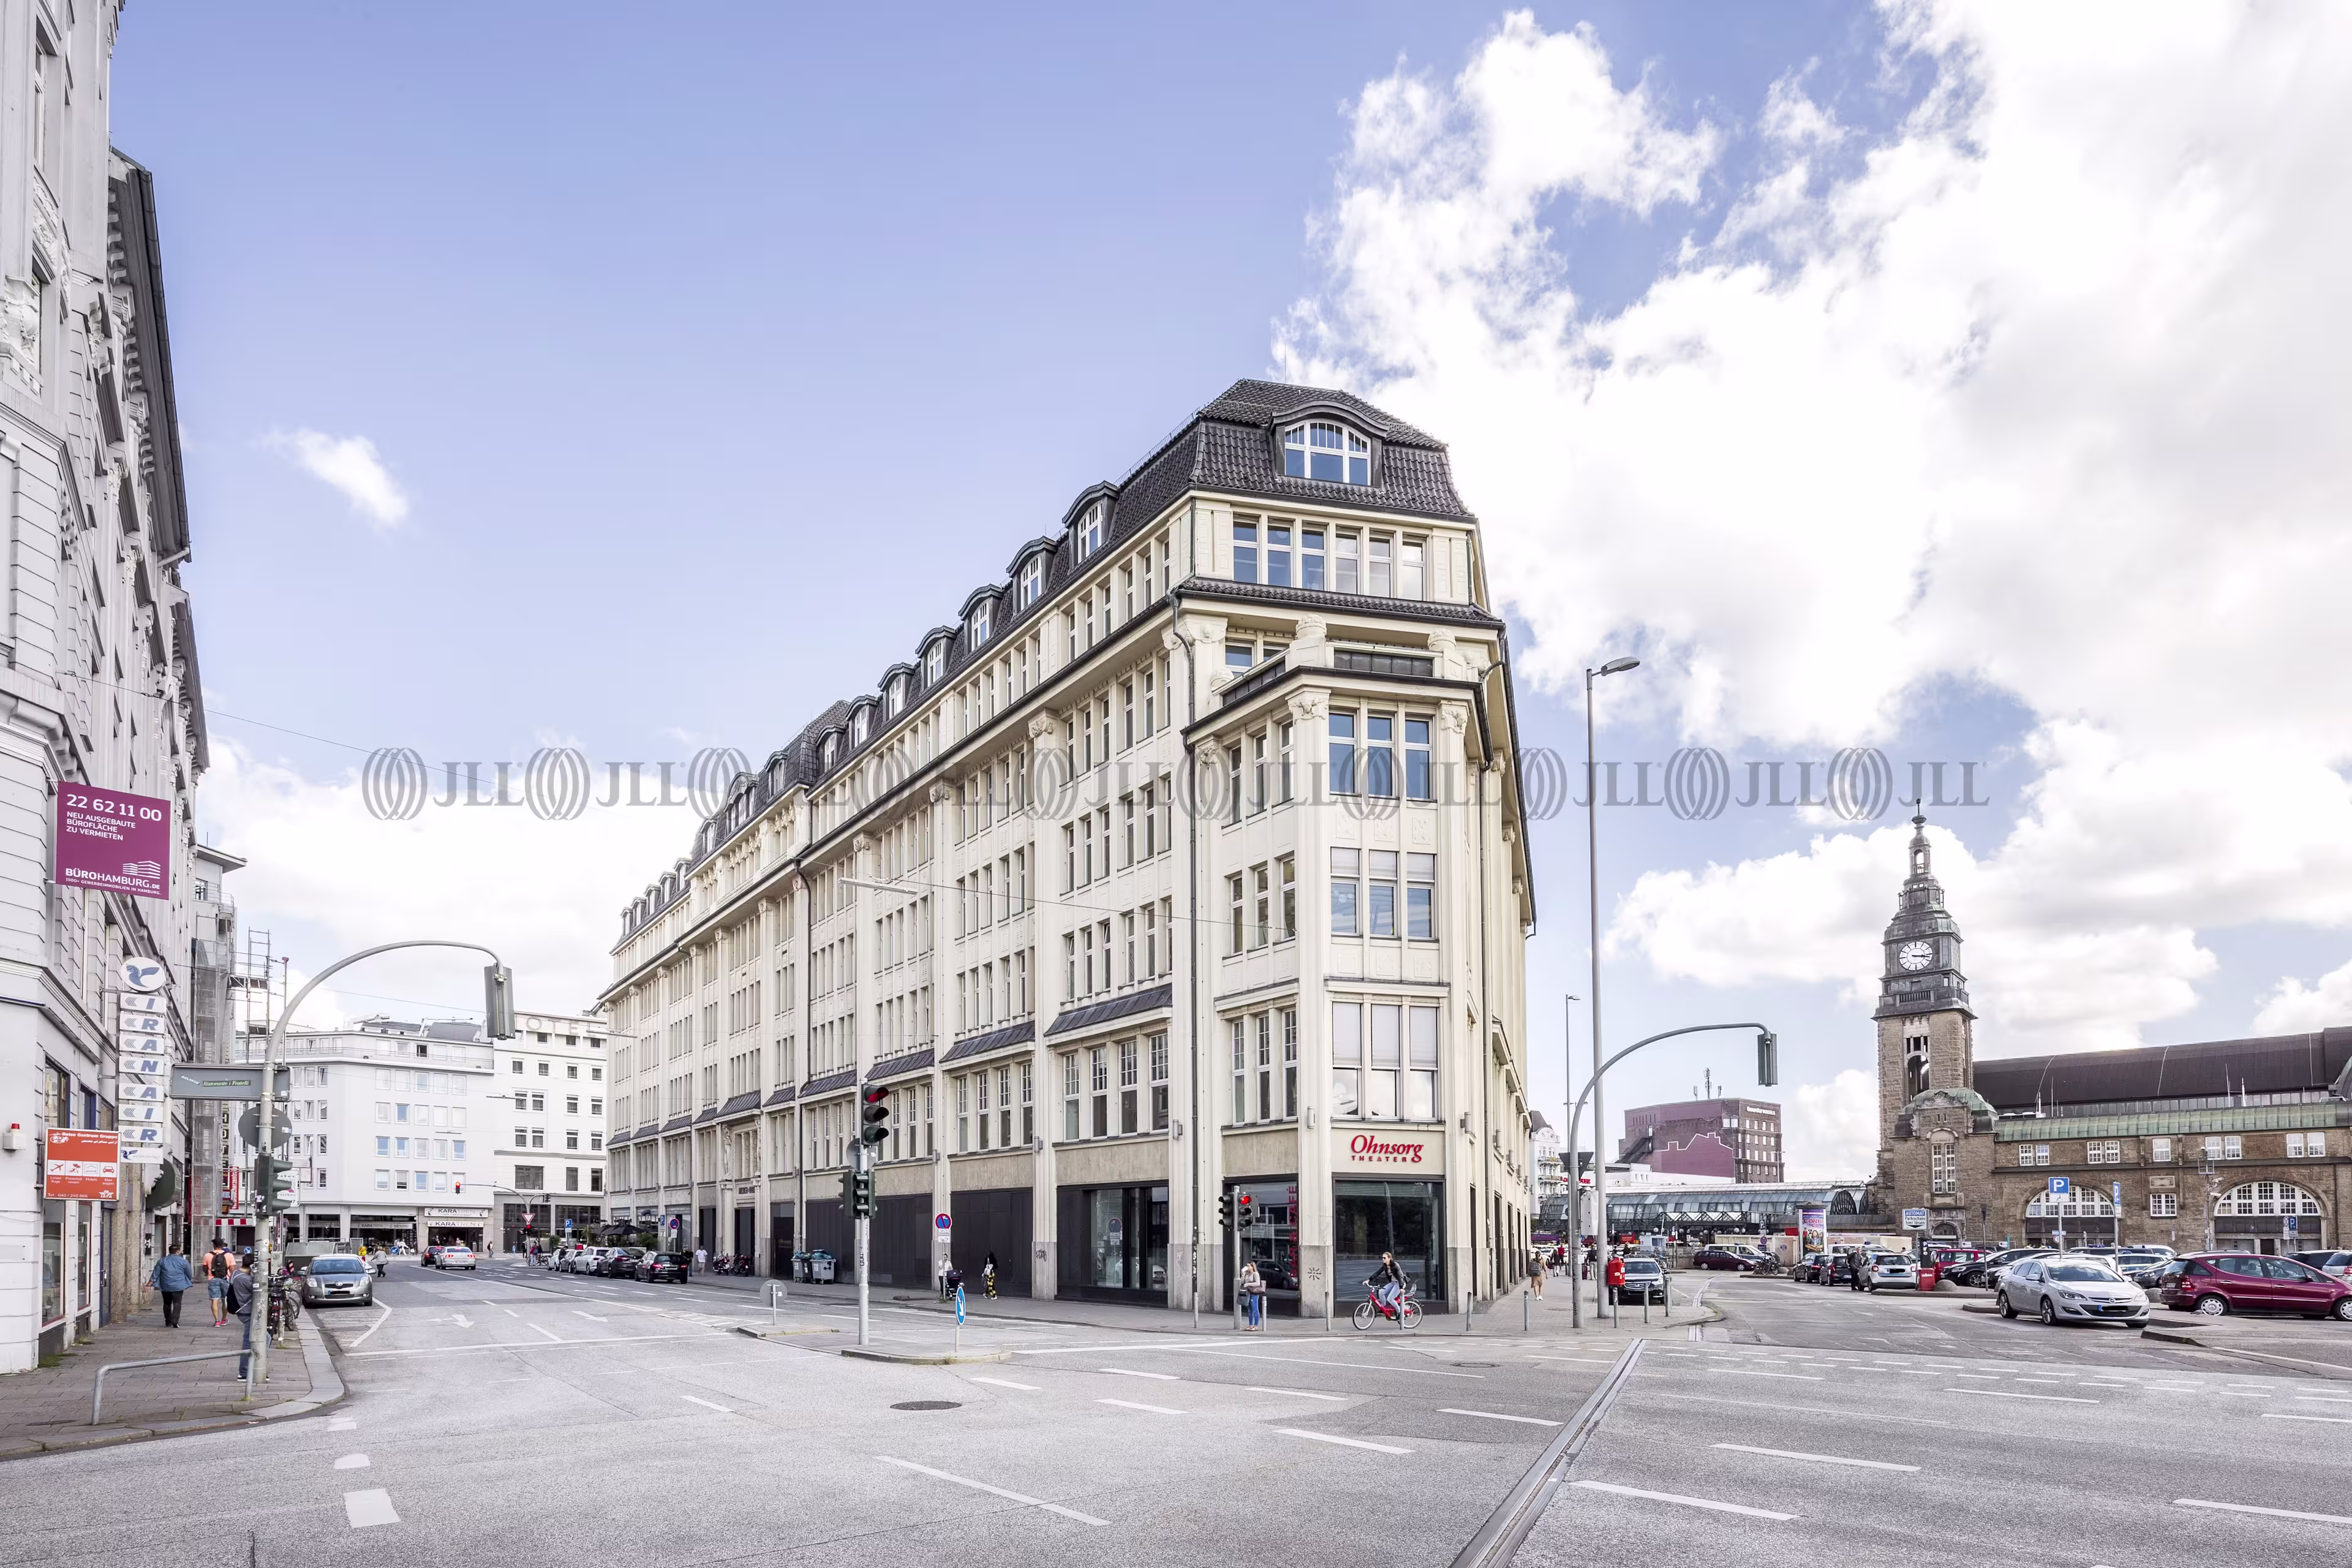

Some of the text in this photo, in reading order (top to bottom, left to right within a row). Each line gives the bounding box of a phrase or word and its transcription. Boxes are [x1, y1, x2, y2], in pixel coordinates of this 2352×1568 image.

[67, 794, 162, 821] 22 62 11 00
[67, 819, 118, 832] BÜROFLÄCHE
[86, 815, 136, 828] AUSGEBAUTE
[80, 828, 123, 840] VERMIETEN
[66, 868, 160, 889] BÜROHAMBURG.DE
[81, 880, 130, 890] GEWERBEIMMOBILIEN
[526, 1016, 597, 1037] OTEL
[1351, 1134, 1424, 1163] Ohnsorg
[2053, 1180, 2064, 1192] P
